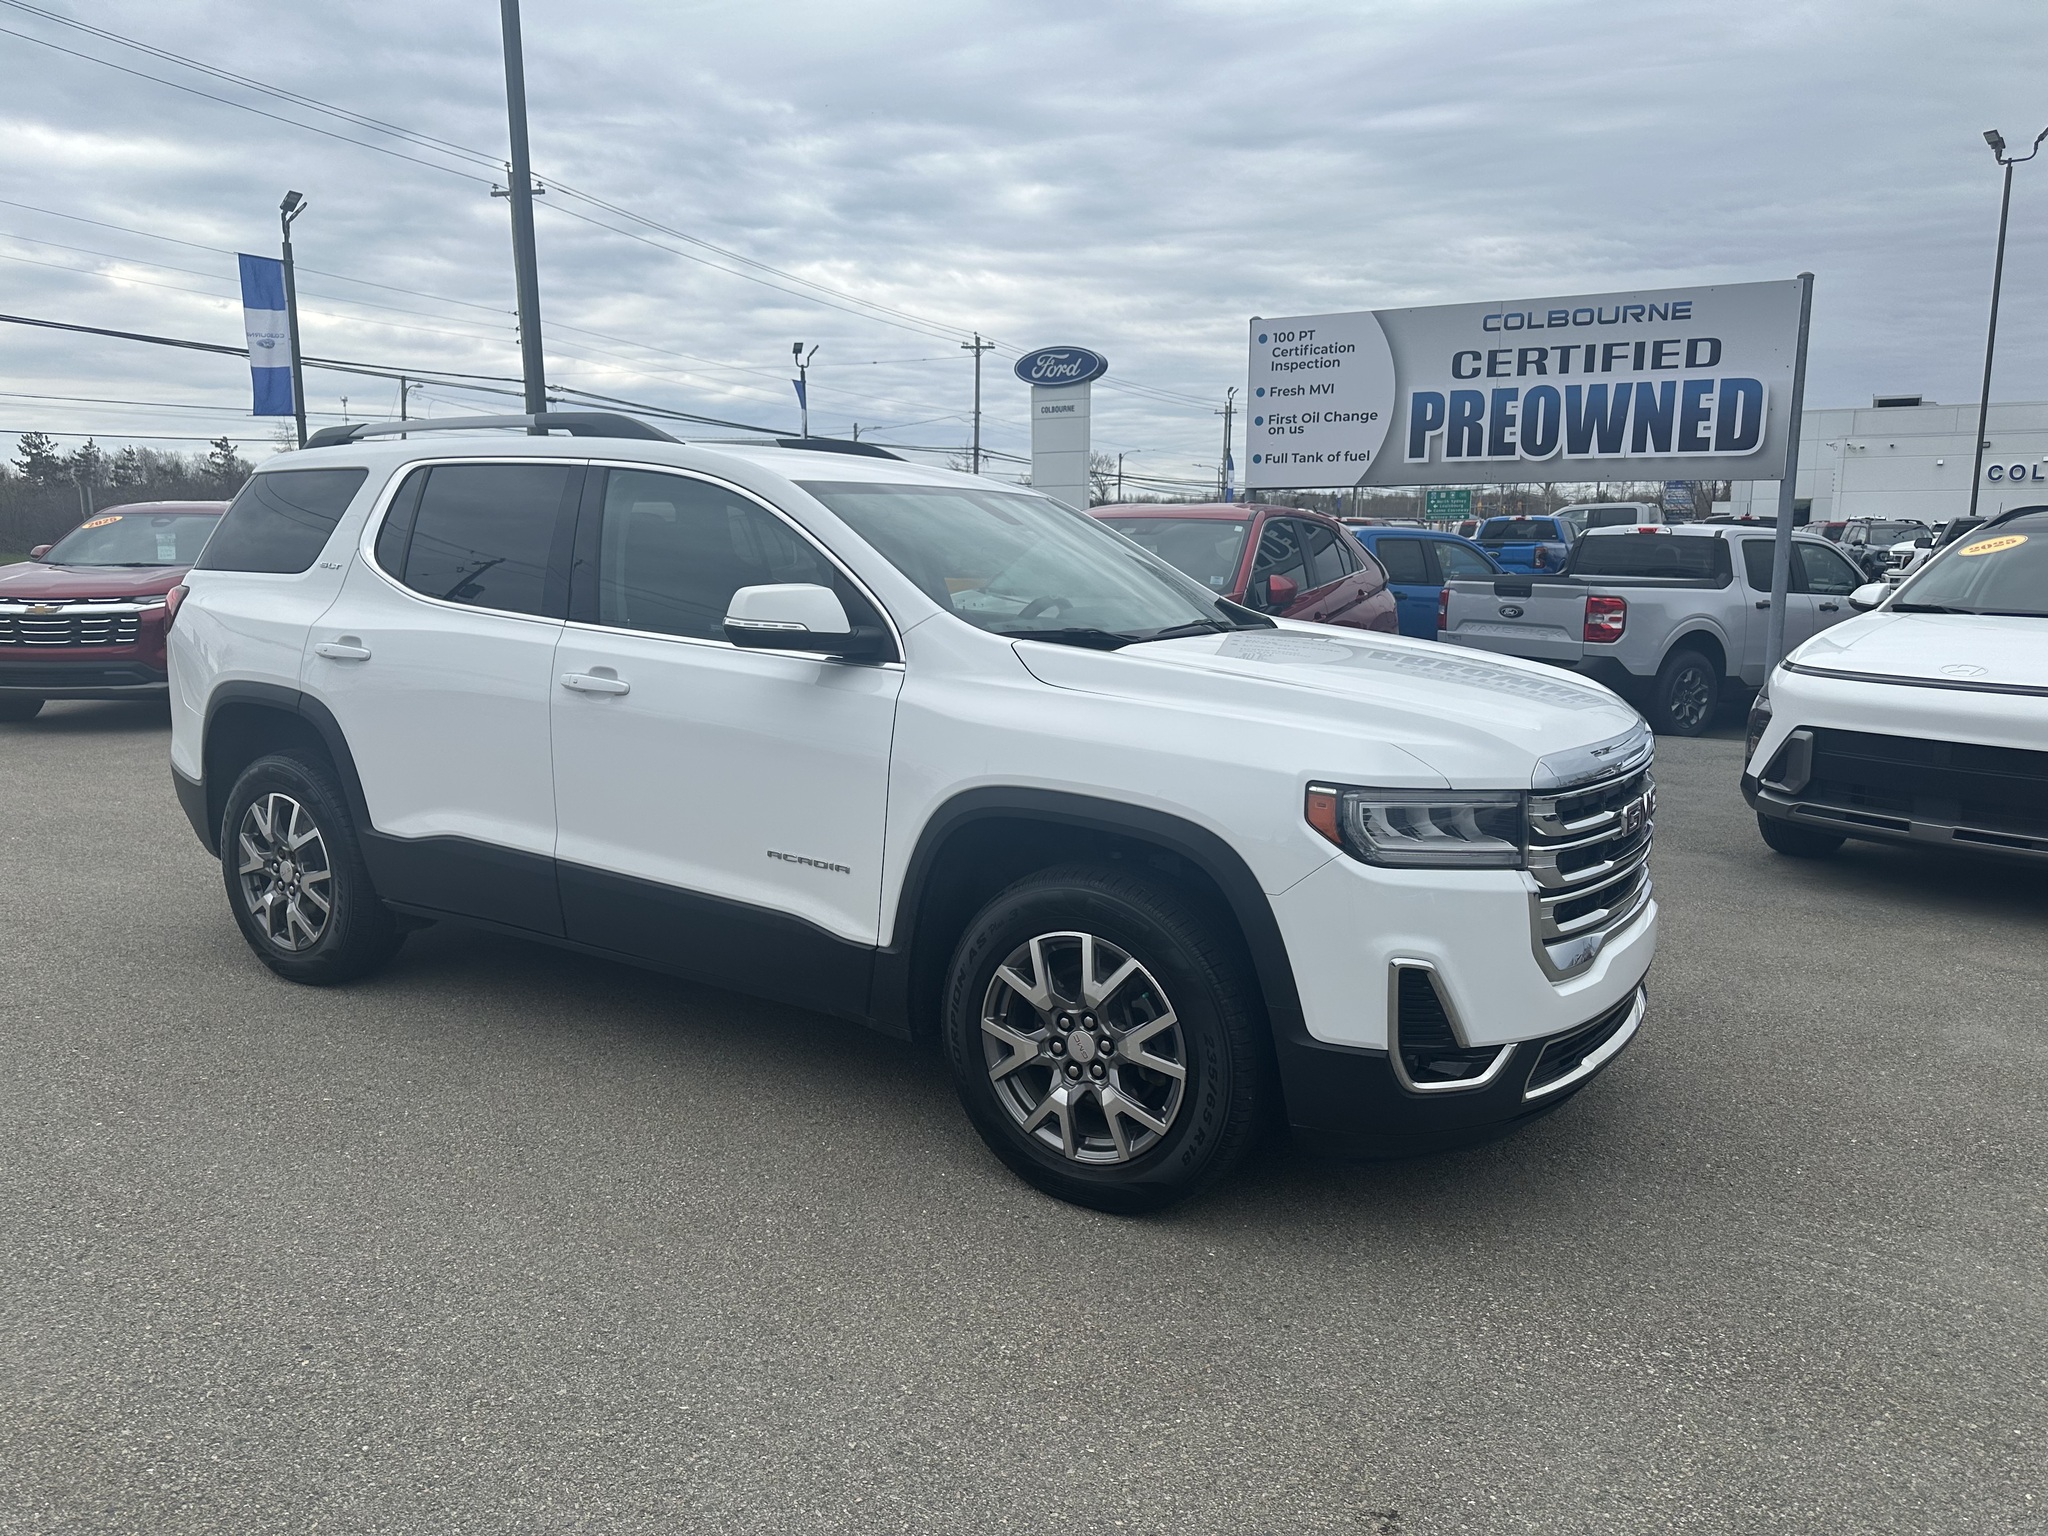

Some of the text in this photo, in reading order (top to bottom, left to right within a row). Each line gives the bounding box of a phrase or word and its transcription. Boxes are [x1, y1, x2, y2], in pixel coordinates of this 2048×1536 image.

[1482, 301, 1693, 332] COLBOURNE
[1272, 330, 1316, 343] 100 PT
[1271, 342, 1355, 358] Certification
[1031, 353, 1082, 379] Ford
[1271, 357, 1341, 373] Inspection
[1451, 337, 1722, 380] CERTIFIED
[1269, 383, 1335, 397] Fresh MVI
[1040, 404, 1075, 414] COLBOURNE
[1268, 411, 1378, 425] First Oil Change
[1407, 376, 1766, 460] PREOWNED
[1268, 425, 1305, 435] on us
[1265, 450, 1371, 464] Full Tank of fuel
[1987, 464, 2045, 481] COL
[1969, 538, 2017, 553] 2025
[766, 850, 851, 875] ACADIA
